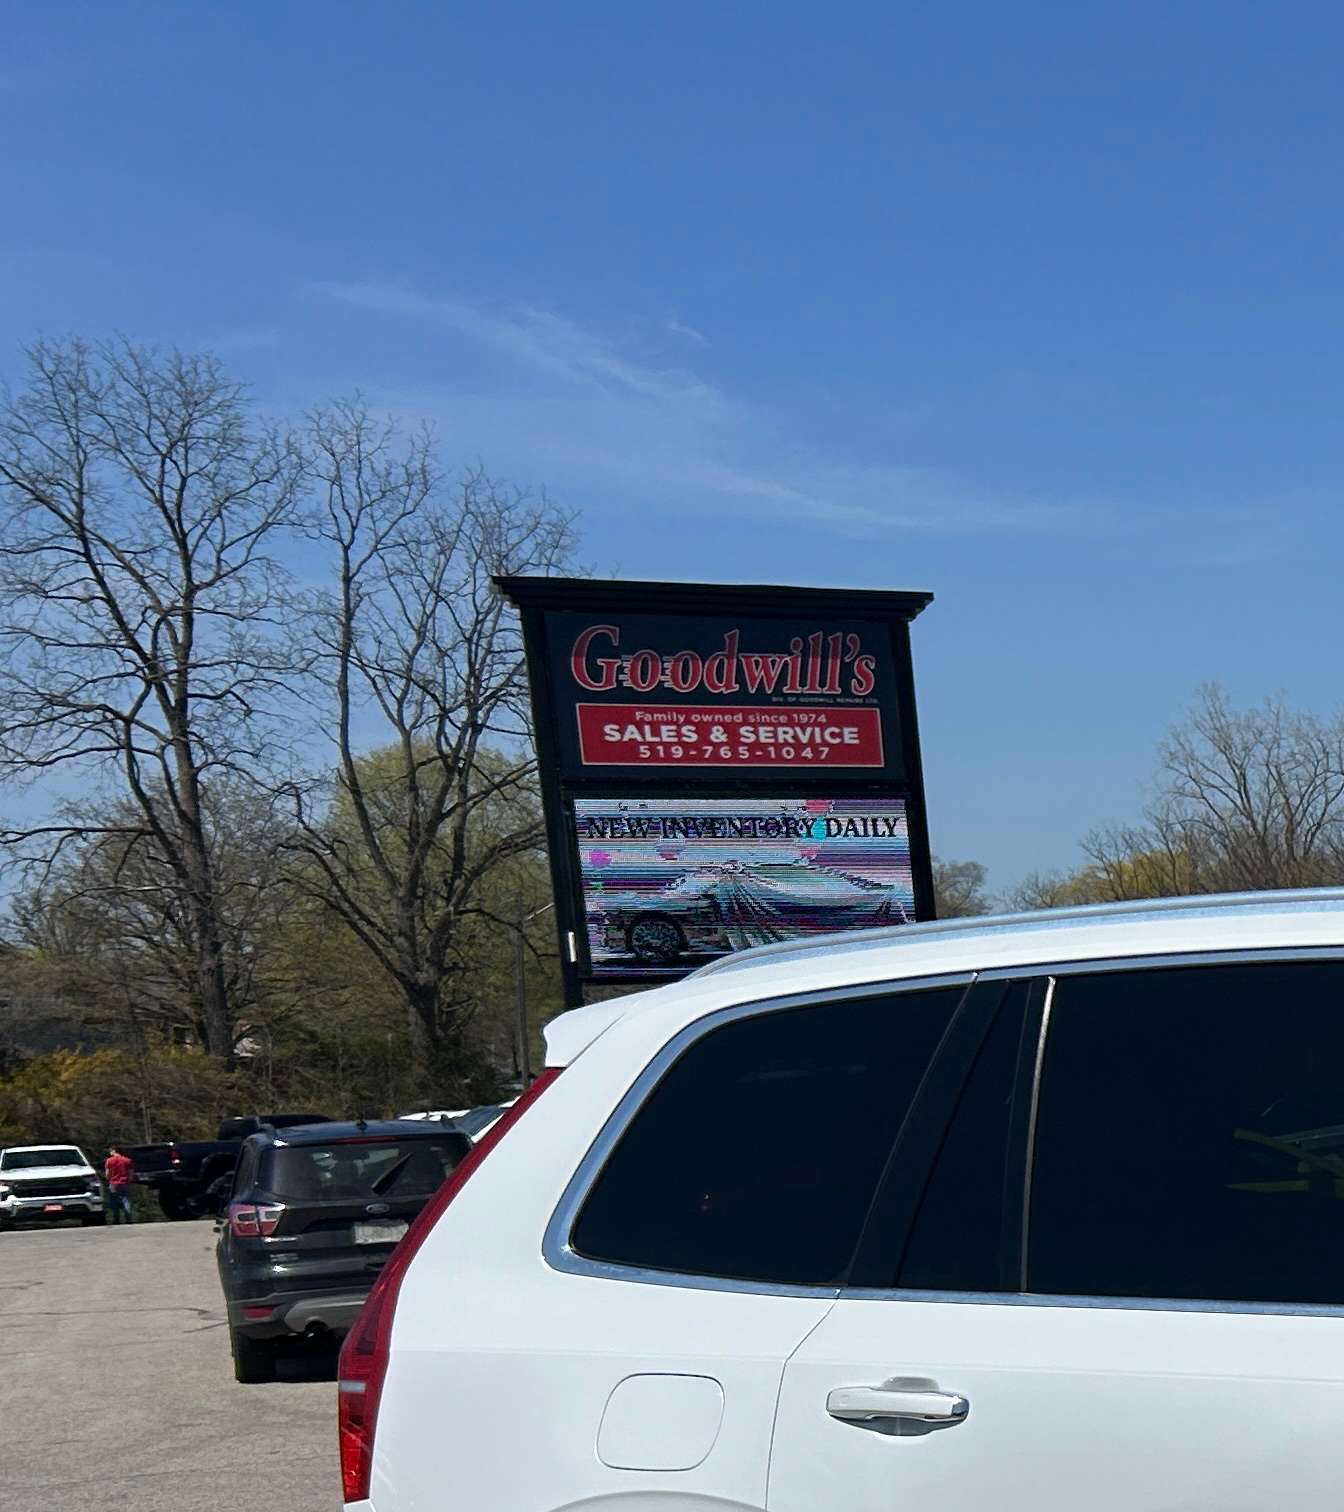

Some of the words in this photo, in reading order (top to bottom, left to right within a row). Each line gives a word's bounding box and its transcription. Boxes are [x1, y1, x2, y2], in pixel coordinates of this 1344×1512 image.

[571, 624, 876, 696] Goodwill's
[635, 711, 686, 723] Family
[691, 712, 743, 723] owned
[748, 713, 788, 723] since
[792, 714, 827, 724] 1974
[603, 724, 699, 742] SALES
[709, 725, 729, 743] &
[739, 725, 860, 744] SERVICE
[639, 746, 830, 760] 519-765-1047
[587, 816, 649, 838] NEW
[660, 816, 816, 839] INVENTORY
[825, 816, 898, 838] DAILY
